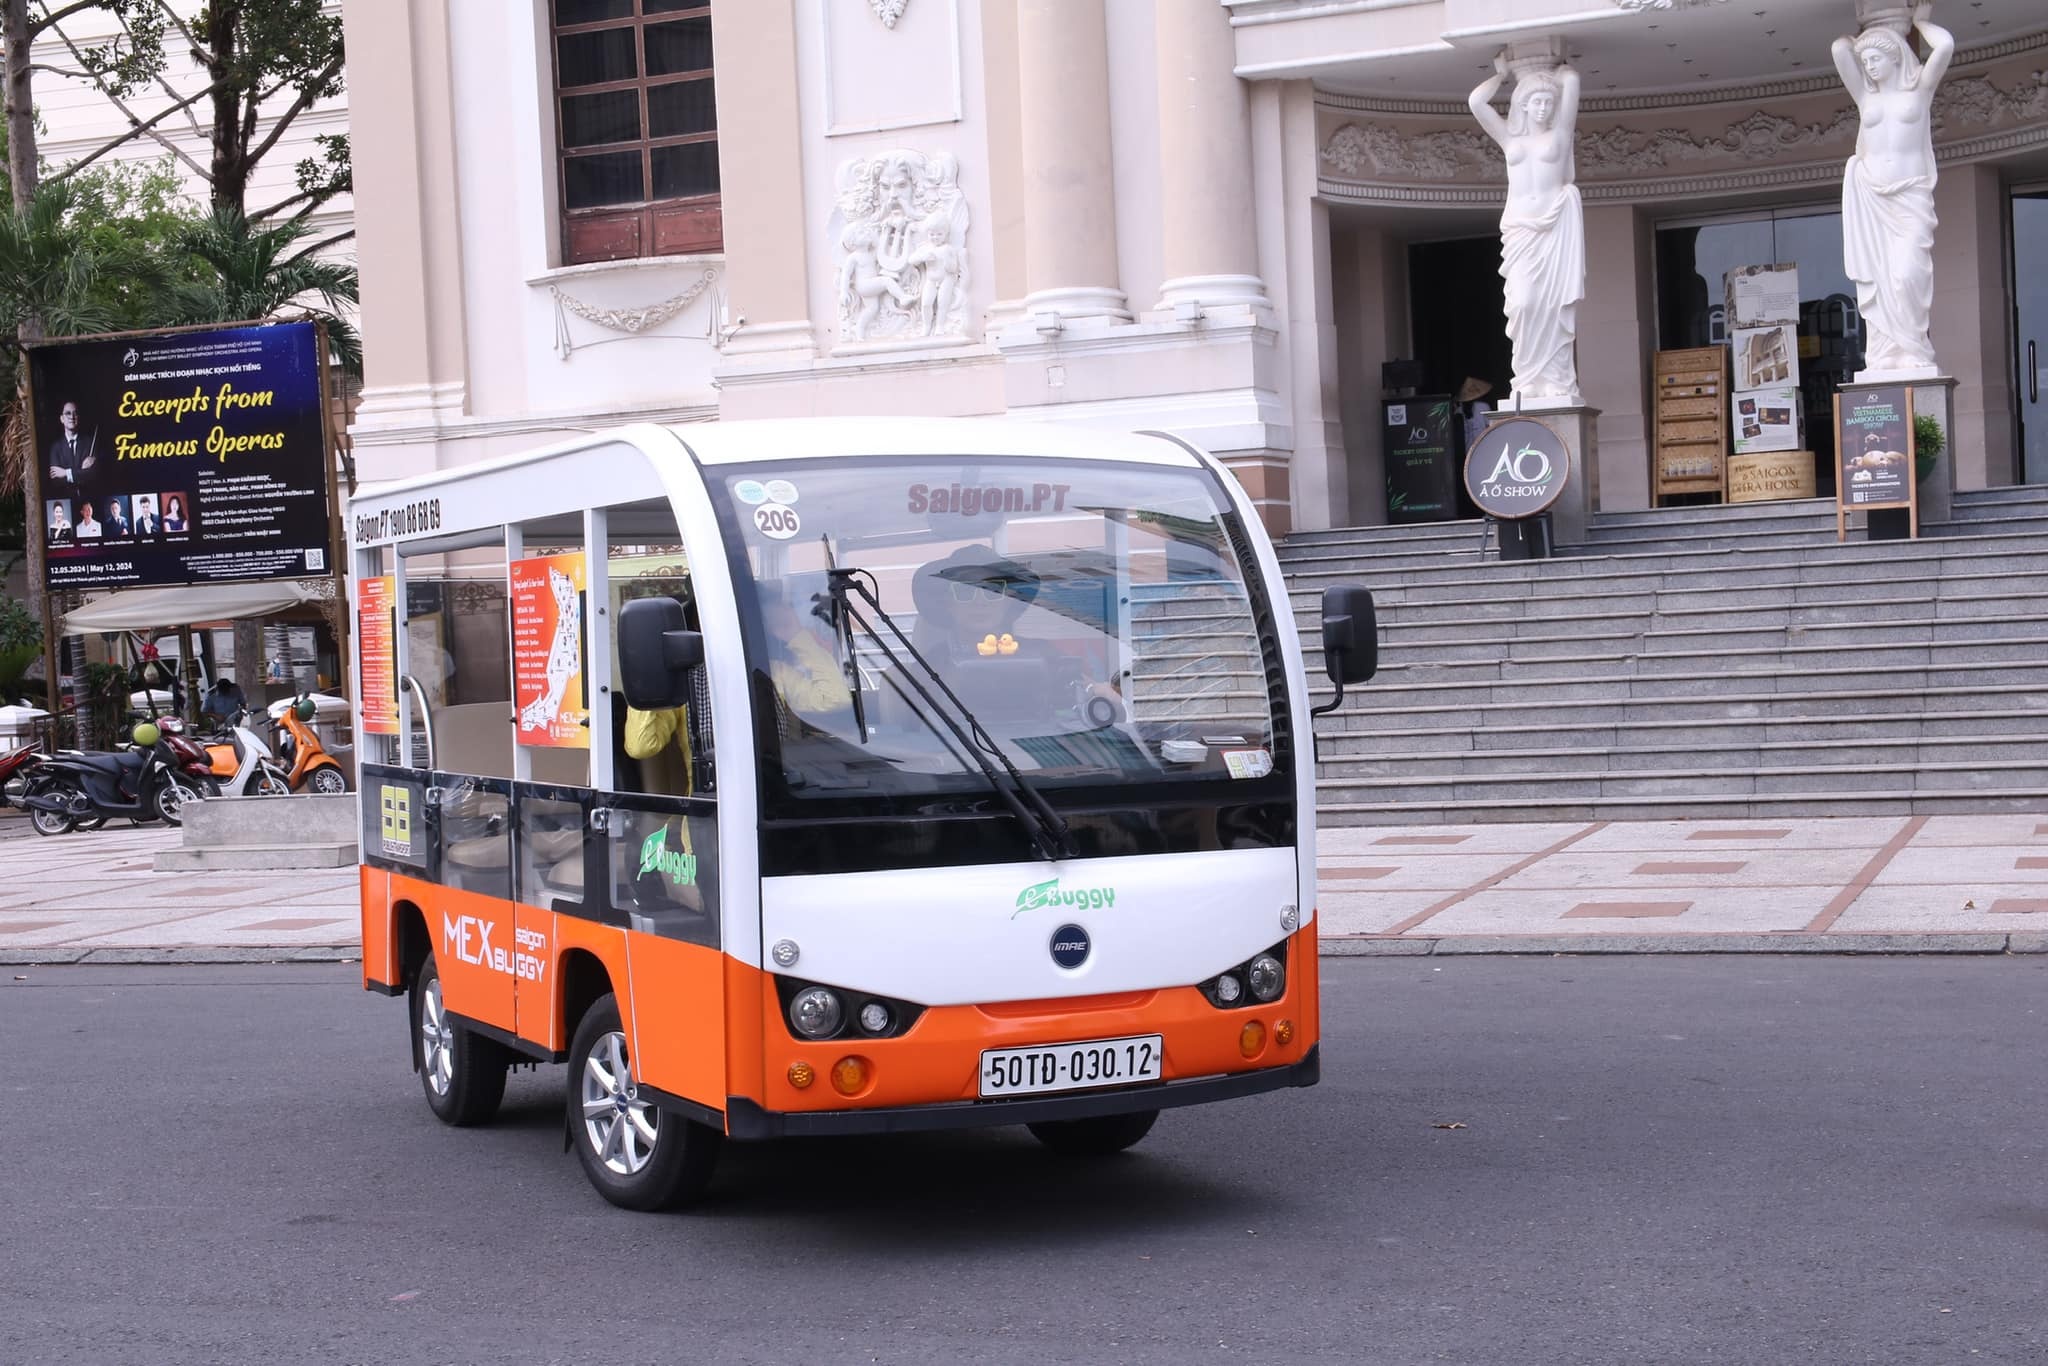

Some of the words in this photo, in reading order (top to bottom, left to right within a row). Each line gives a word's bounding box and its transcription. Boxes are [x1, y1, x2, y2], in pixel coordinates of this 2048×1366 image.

[119, 386, 210, 423] Excerpts
[215, 383, 273, 420] from
[115, 432, 198, 460] Famous
[206, 426, 284, 462] Operas
[1750, 466, 1795, 479] SAIGON
[1765, 480, 1800, 490] HOUSE
[908, 482, 1071, 516] Saigon.PT
[1504, 485, 1547, 497] SHOW
[390, 509, 405, 537] 1900
[407, 504, 417, 534] 88
[418, 501, 428, 532] 68
[430, 498, 440, 530] 69
[757, 510, 798, 532] 206
[90, 564, 104, 574] May
[106, 563, 115, 572] 12,
[116, 562, 133, 570] 2024
[444, 911, 495, 968] MEX
[495, 946, 546, 983] BUGGY
[516, 926, 546, 950] saigon
[992, 1042, 1152, 1088] 50TD-030.12
